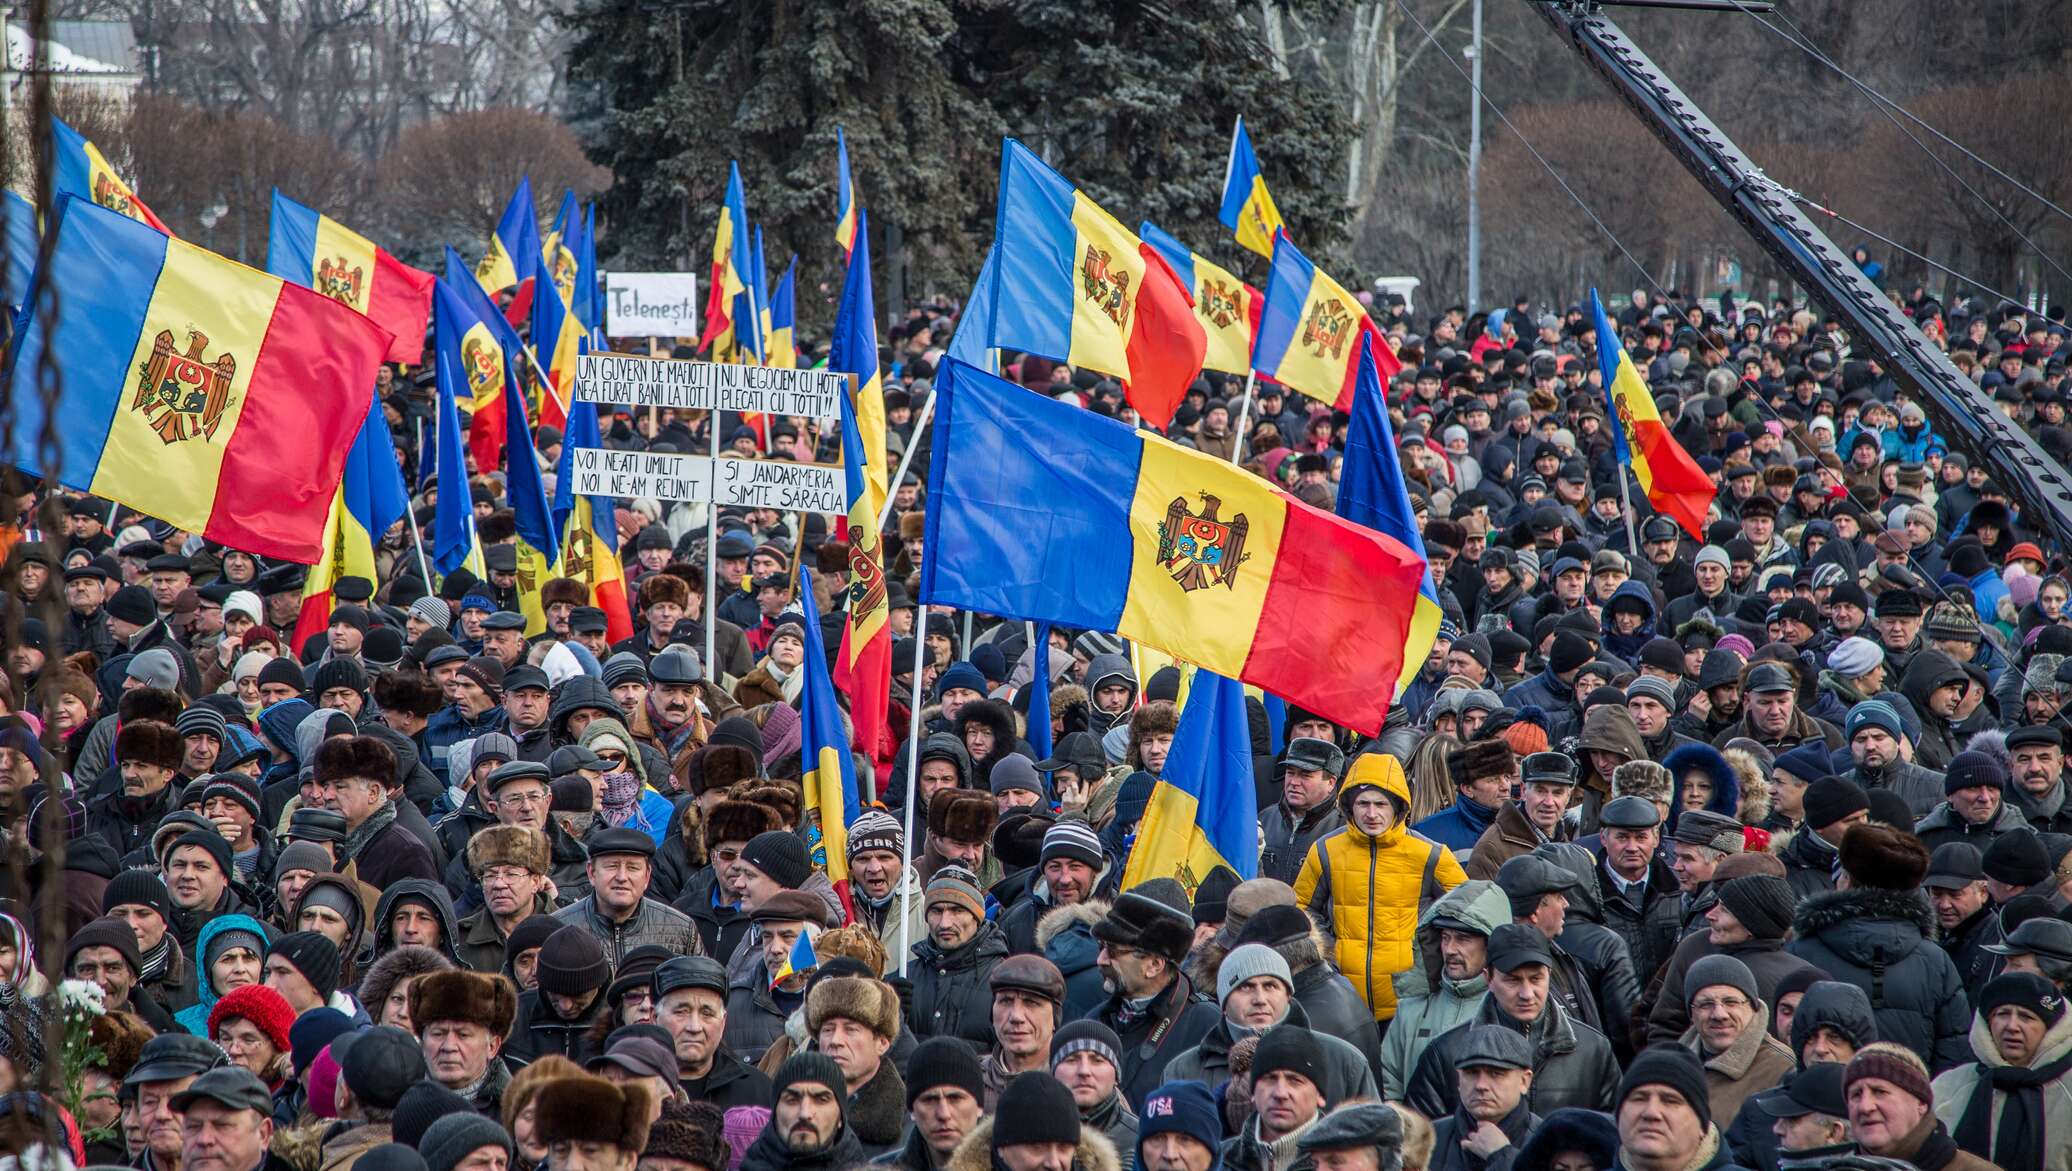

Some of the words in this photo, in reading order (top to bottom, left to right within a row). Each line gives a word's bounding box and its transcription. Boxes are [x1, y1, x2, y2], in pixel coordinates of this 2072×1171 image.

[577, 356, 597, 380] UN
[652, 360, 665, 383] DE
[667, 362, 711, 386] MAFIOTI
[721, 364, 738, 388] NU
[743, 366, 796, 392] NEGOCIEM
[799, 371, 813, 393] CU
[602, 380, 634, 402] FURAT
[638, 382, 664, 405] BANII
[668, 384, 682, 406] LA
[682, 385, 709, 408] TOTI
[721, 389, 763, 411] PLECATI
[770, 392, 785, 412] CU
[575, 449, 597, 470] VOI
[645, 455, 684, 476] UMILIT
[580, 473, 600, 492] NOI
[610, 475, 647, 496] NE-AM
[655, 477, 700, 499] REUNIT
[747, 463, 834, 489] JANDARMERIA
[727, 484, 772, 505] SIMTE
[1147, 1096, 1173, 1118] USA
